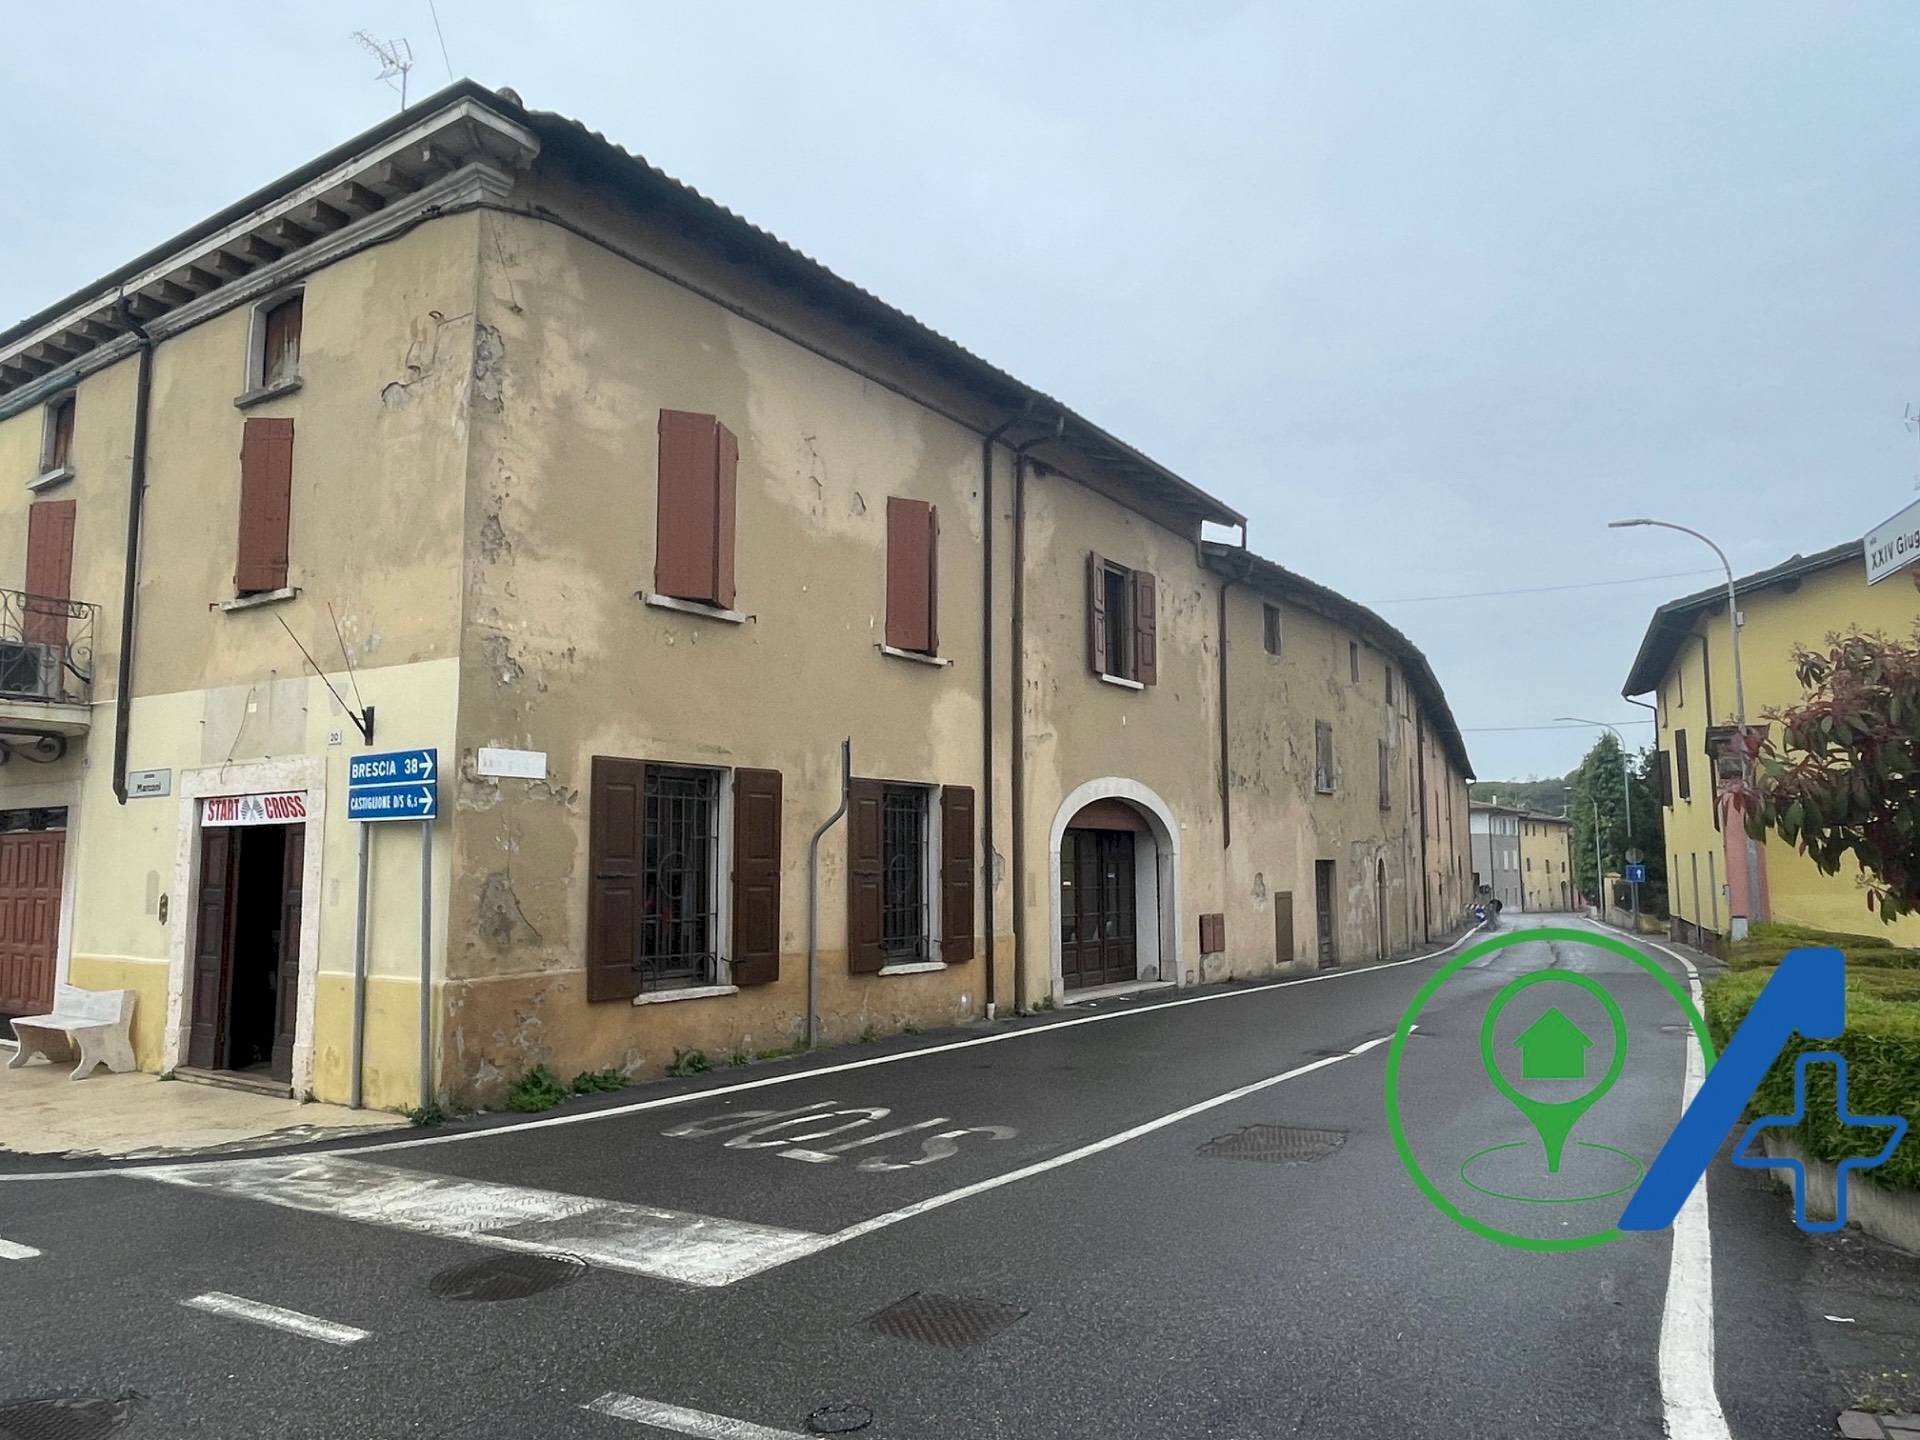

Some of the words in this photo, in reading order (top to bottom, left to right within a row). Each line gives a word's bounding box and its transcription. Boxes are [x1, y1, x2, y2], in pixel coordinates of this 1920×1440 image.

[1871, 541, 1894, 571] XXIV
[351, 760, 397, 779] BRESCIA
[404, 758, 418, 775] 38
[208, 798, 240, 822] START
[263, 795, 307, 820] CROSS
[350, 795, 391, 811] CASTIGLIONE
